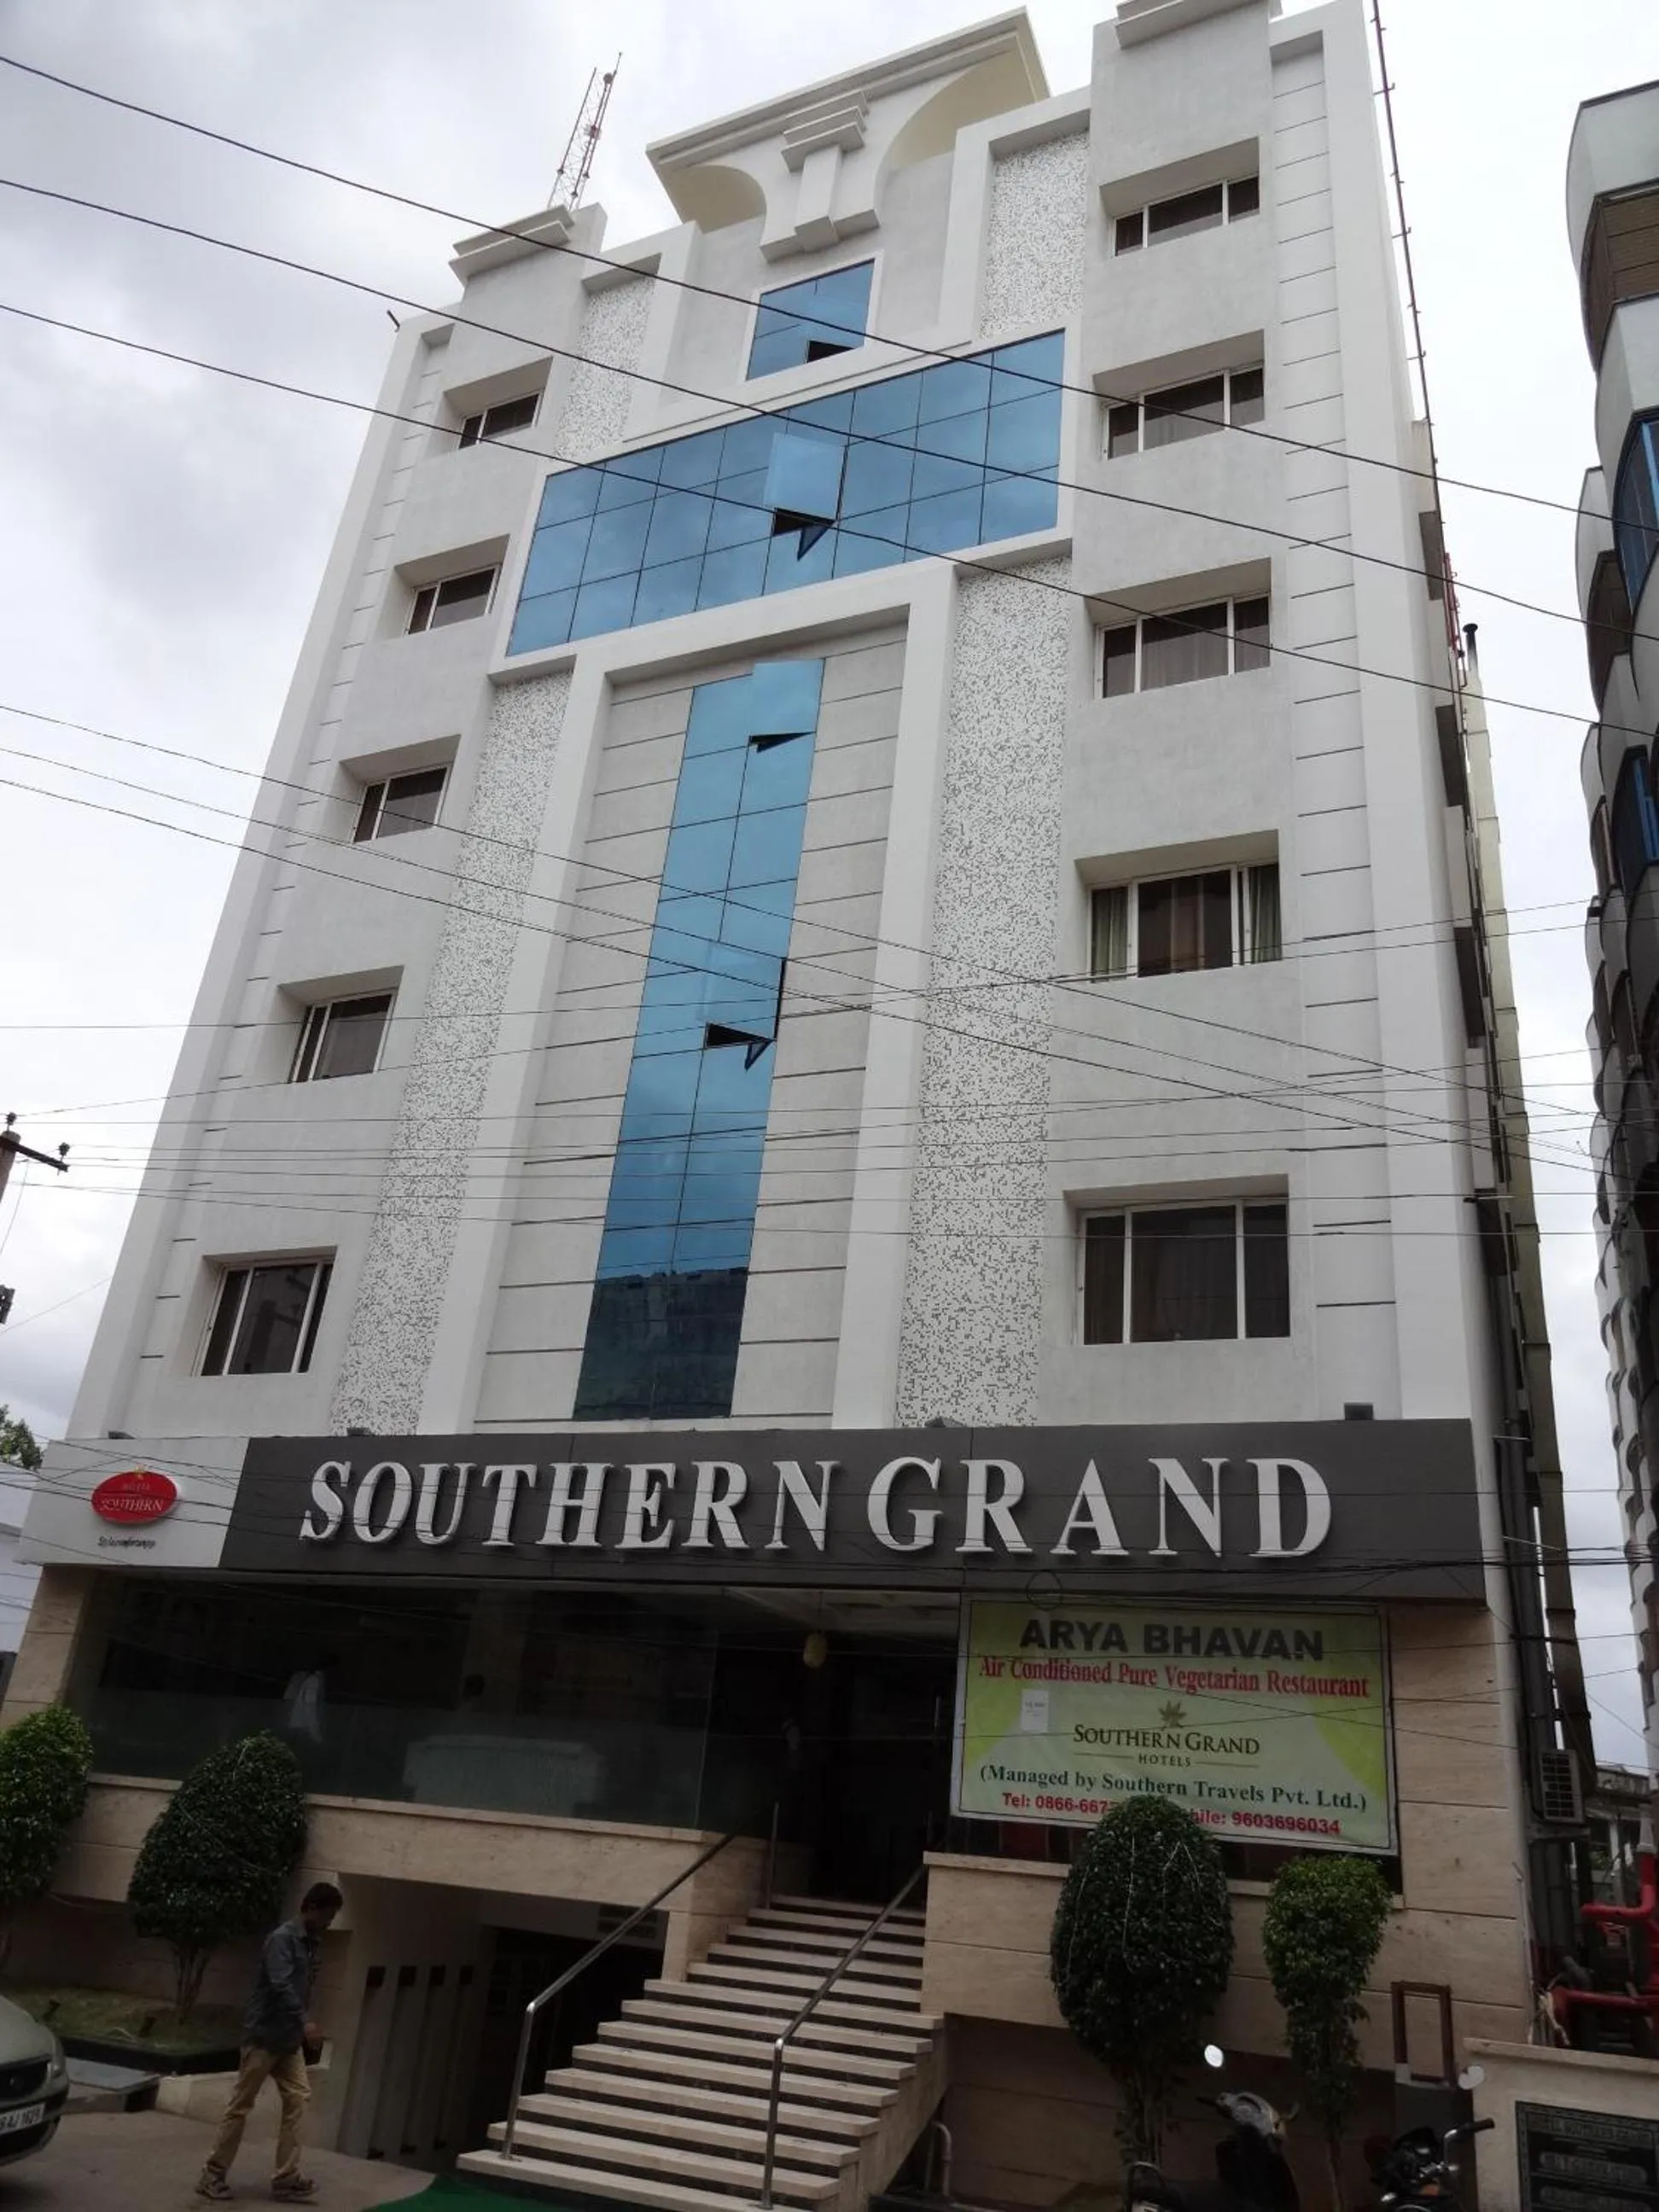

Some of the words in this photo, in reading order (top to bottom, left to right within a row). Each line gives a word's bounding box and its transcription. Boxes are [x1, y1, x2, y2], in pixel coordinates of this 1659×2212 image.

[299, 1459, 841, 1551] SOUTHERN
[866, 1456, 1332, 1558] GRAND
[1020, 1619, 1128, 1653] ARYA
[1144, 1624, 1323, 1662] BHAVAN
[980, 1655, 1006, 1679] Air
[1010, 1657, 1111, 1684] Conditioned
[1119, 1663, 1157, 1687] Pure
[1165, 1665, 1260, 1695] Vegetarian
[1266, 1669, 1371, 1698] Restaurant
[1073, 1724, 1180, 1749] SOUTHERN
[1185, 1732, 1260, 1755] GRAND
[1138, 1753, 1191, 1768] HOTELS
[981, 1764, 1068, 1789] (Managed
[1075, 1771, 1097, 1791] by
[1102, 1773, 1188, 1796] Southern
[1194, 1780, 1265, 1802] Travels
[1272, 1786, 1310, 1806] Pvt.
[1317, 1790, 1366, 1811] Ltd.)
[1002, 1792, 1031, 1808] Tel:
[1035, 1795, 1120, 1815] 0866-667
[1231, 1811, 1342, 1835] 9603696034
